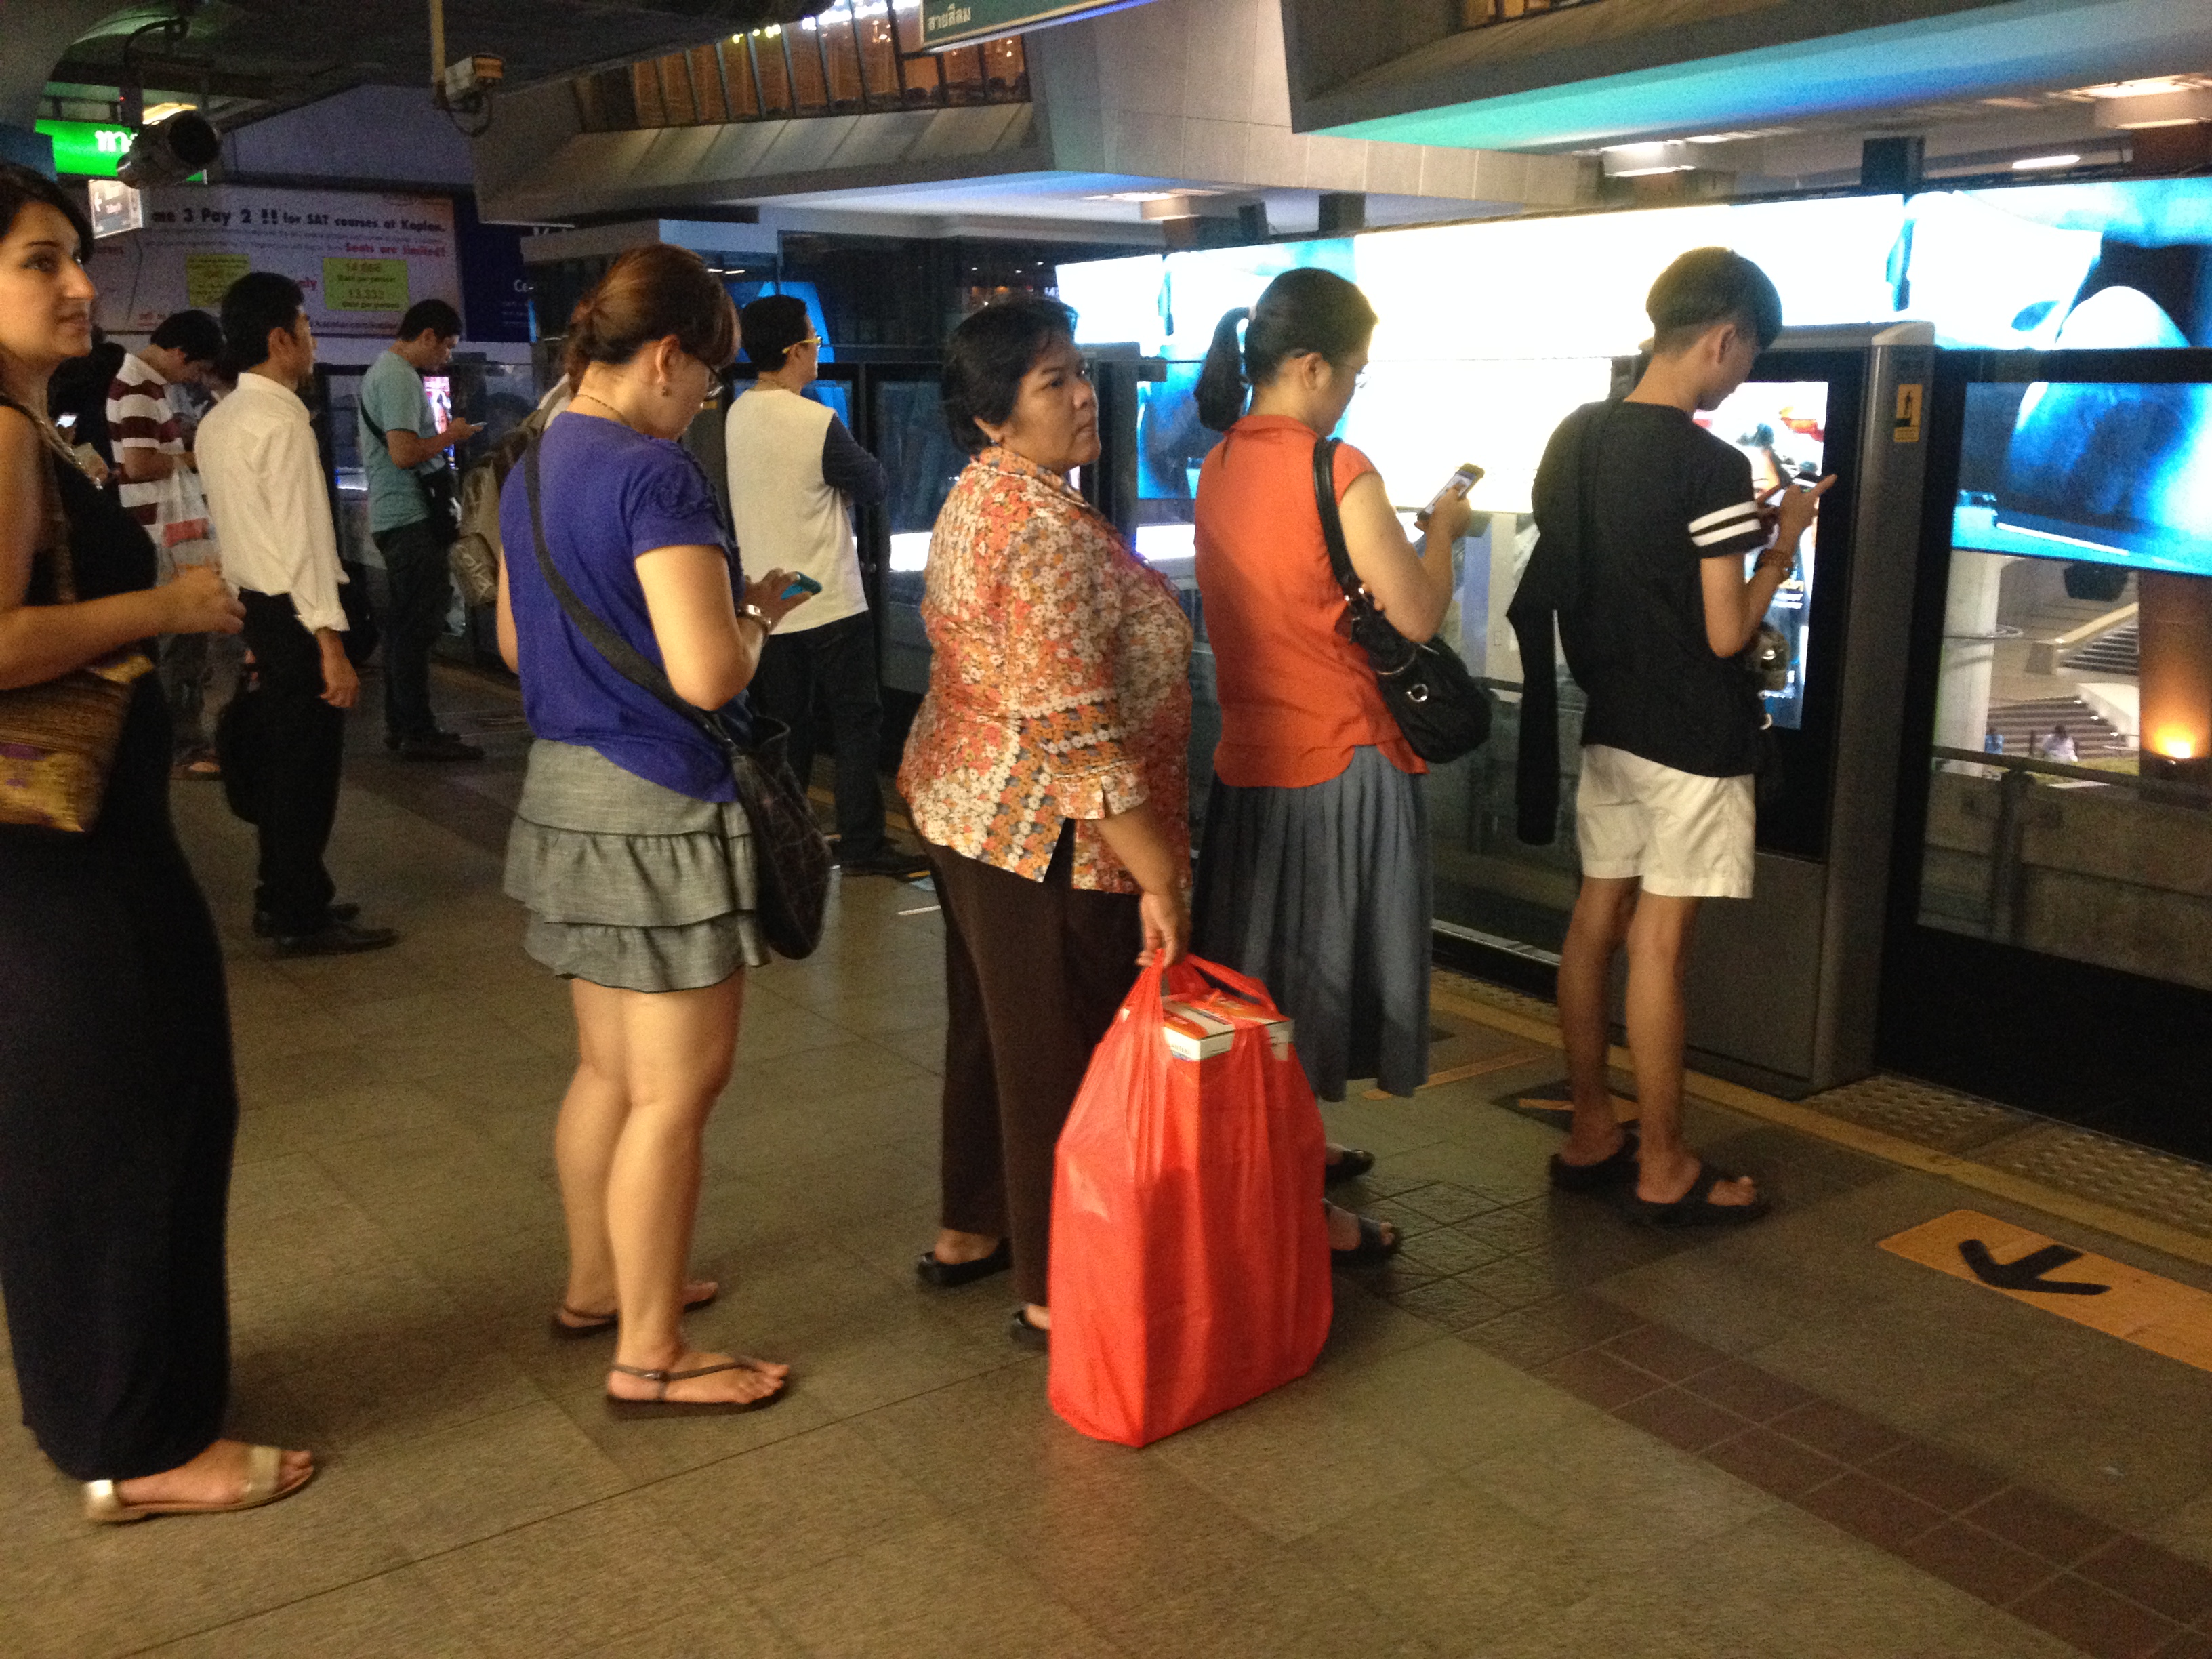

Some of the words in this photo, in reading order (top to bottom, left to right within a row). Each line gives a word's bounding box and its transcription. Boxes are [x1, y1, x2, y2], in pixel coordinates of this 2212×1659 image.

[184, 207, 194, 222] 3
[201, 207, 231, 226] Pay
[241, 209, 252, 223] 2
[283, 211, 301, 223] for
[307, 213, 329, 225] SAT
[335, 218, 378, 228] courses
[384, 219, 395, 229] at
